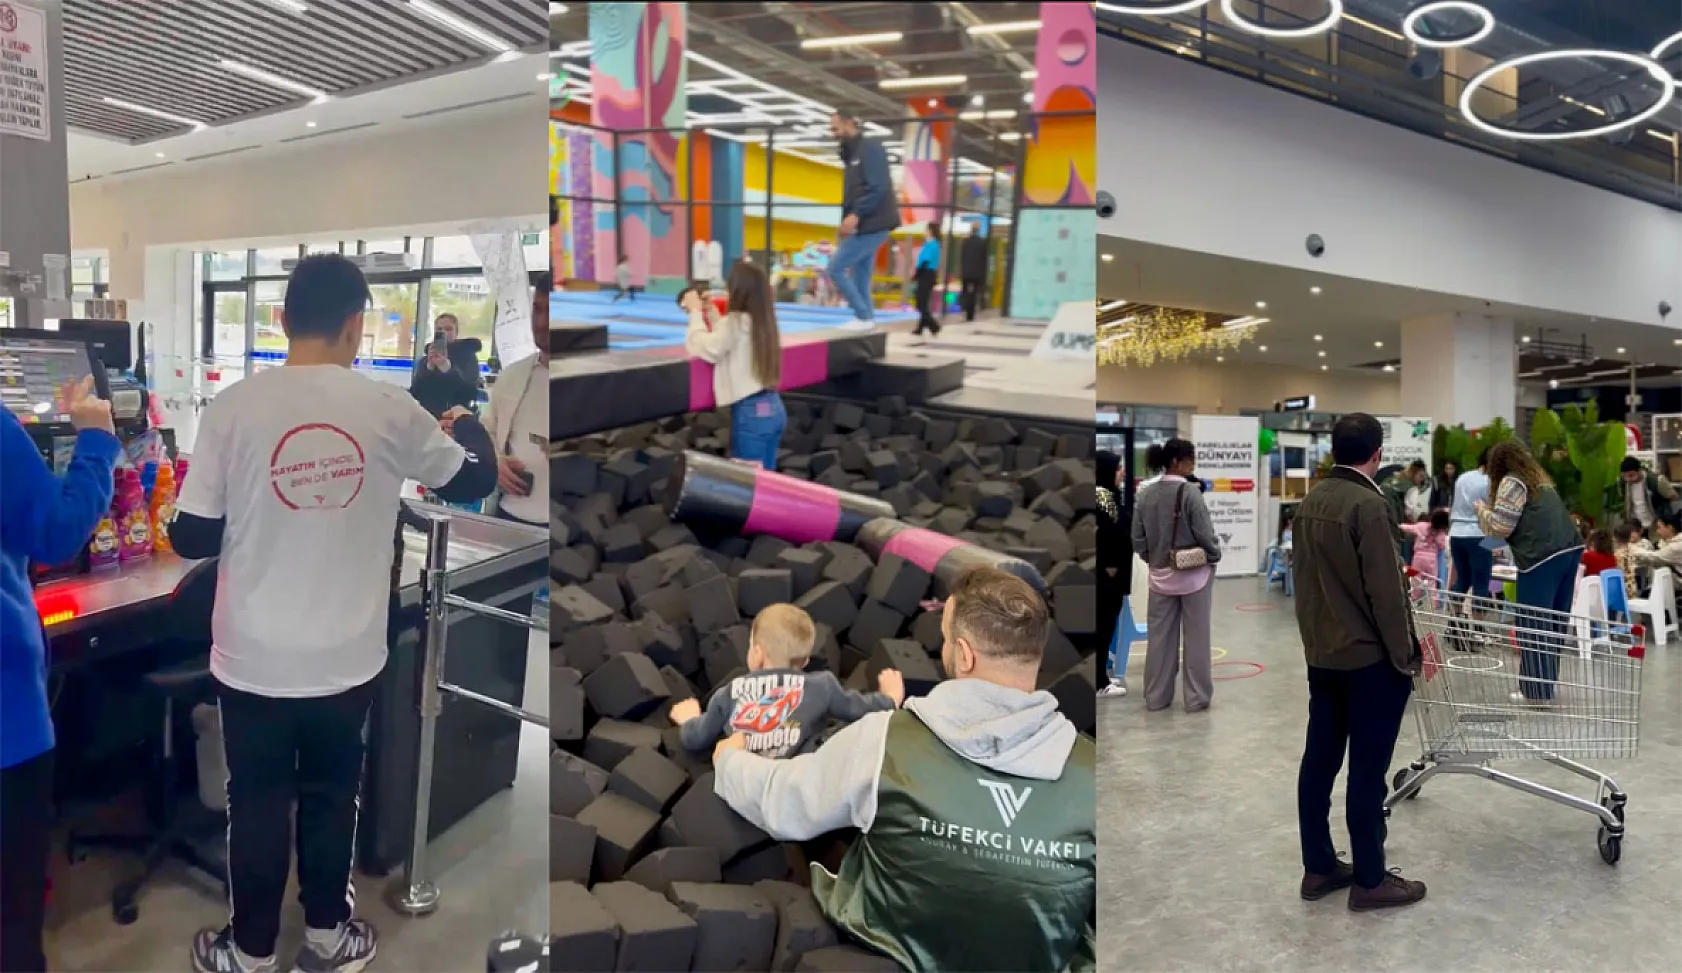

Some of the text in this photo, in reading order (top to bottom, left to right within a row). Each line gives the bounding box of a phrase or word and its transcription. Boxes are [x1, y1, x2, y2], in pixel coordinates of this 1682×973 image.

[1197, 449, 1252, 461] DÜNYAYI
[271, 461, 315, 477] HAYATIN
[332, 467, 364, 479] VARIM
[1020, 836, 1081, 859] VAKFI
